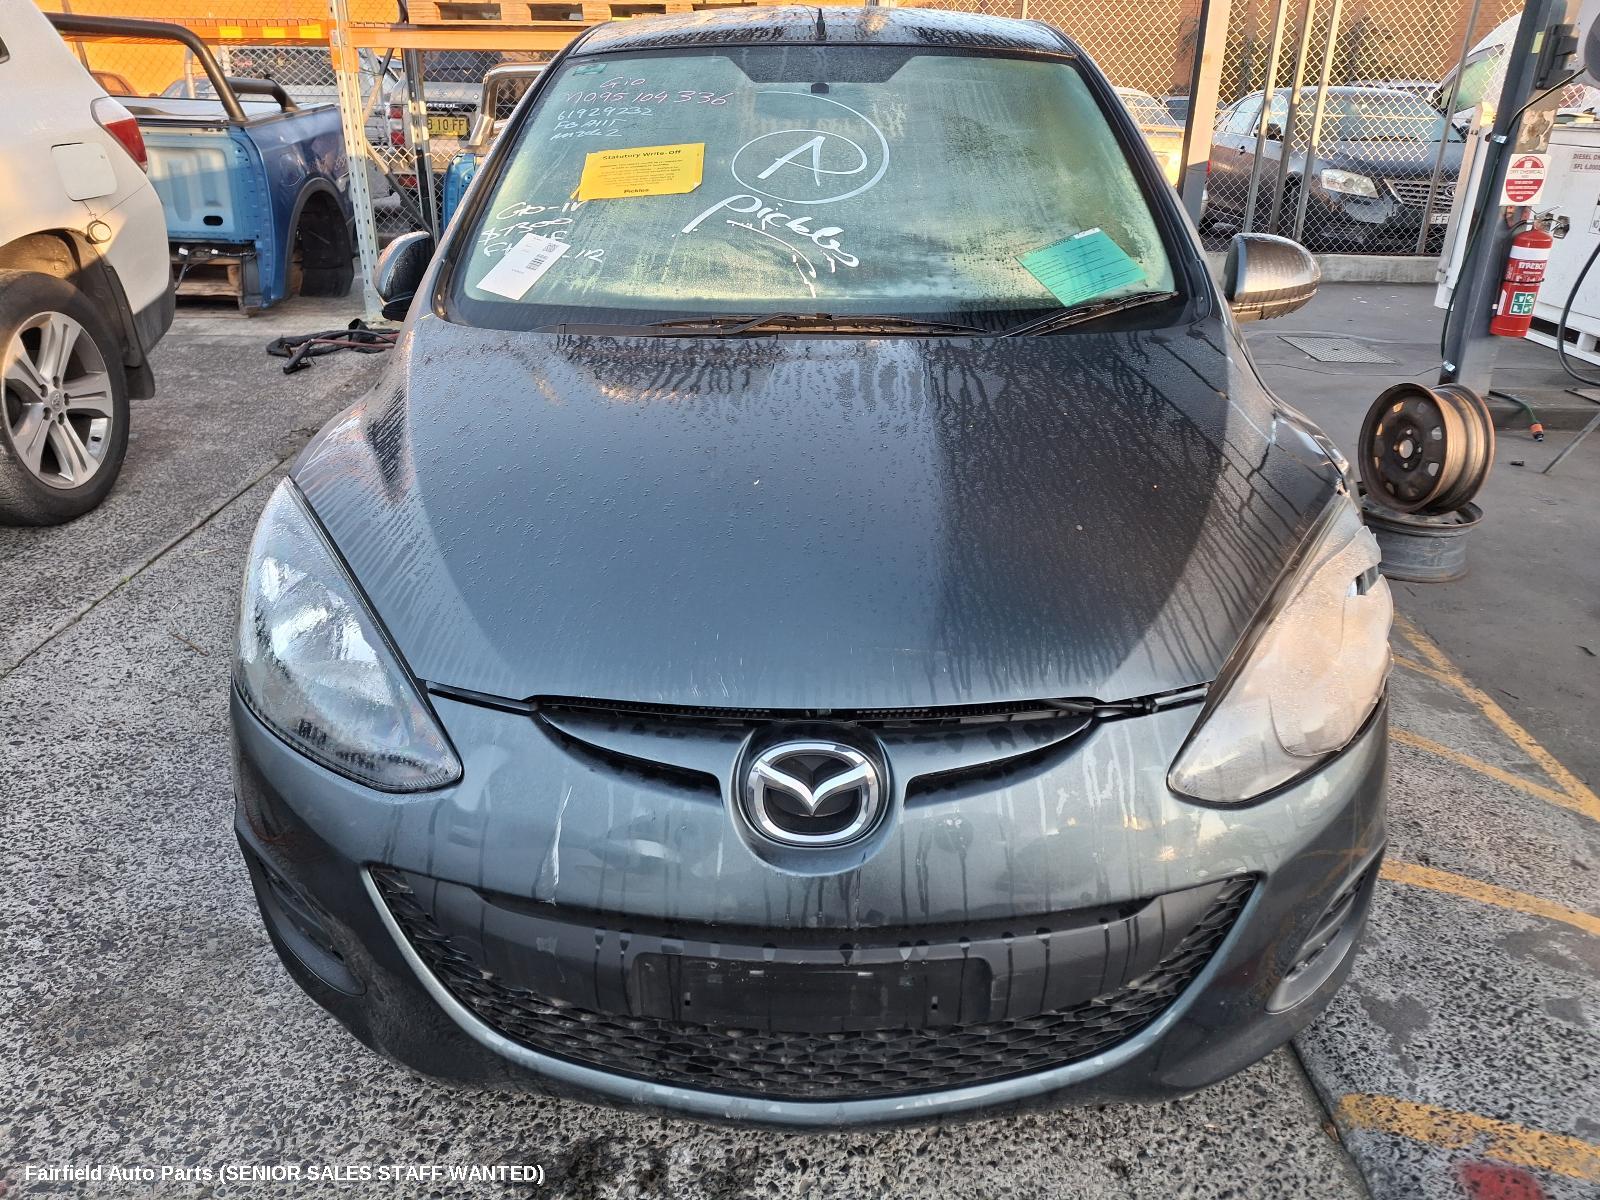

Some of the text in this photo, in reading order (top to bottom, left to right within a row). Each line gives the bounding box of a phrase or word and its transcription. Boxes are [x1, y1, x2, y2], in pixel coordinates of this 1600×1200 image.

[674, 91, 735, 105] 336
[602, 152, 640, 161] Statutory
[757, 135, 826, 187] A
